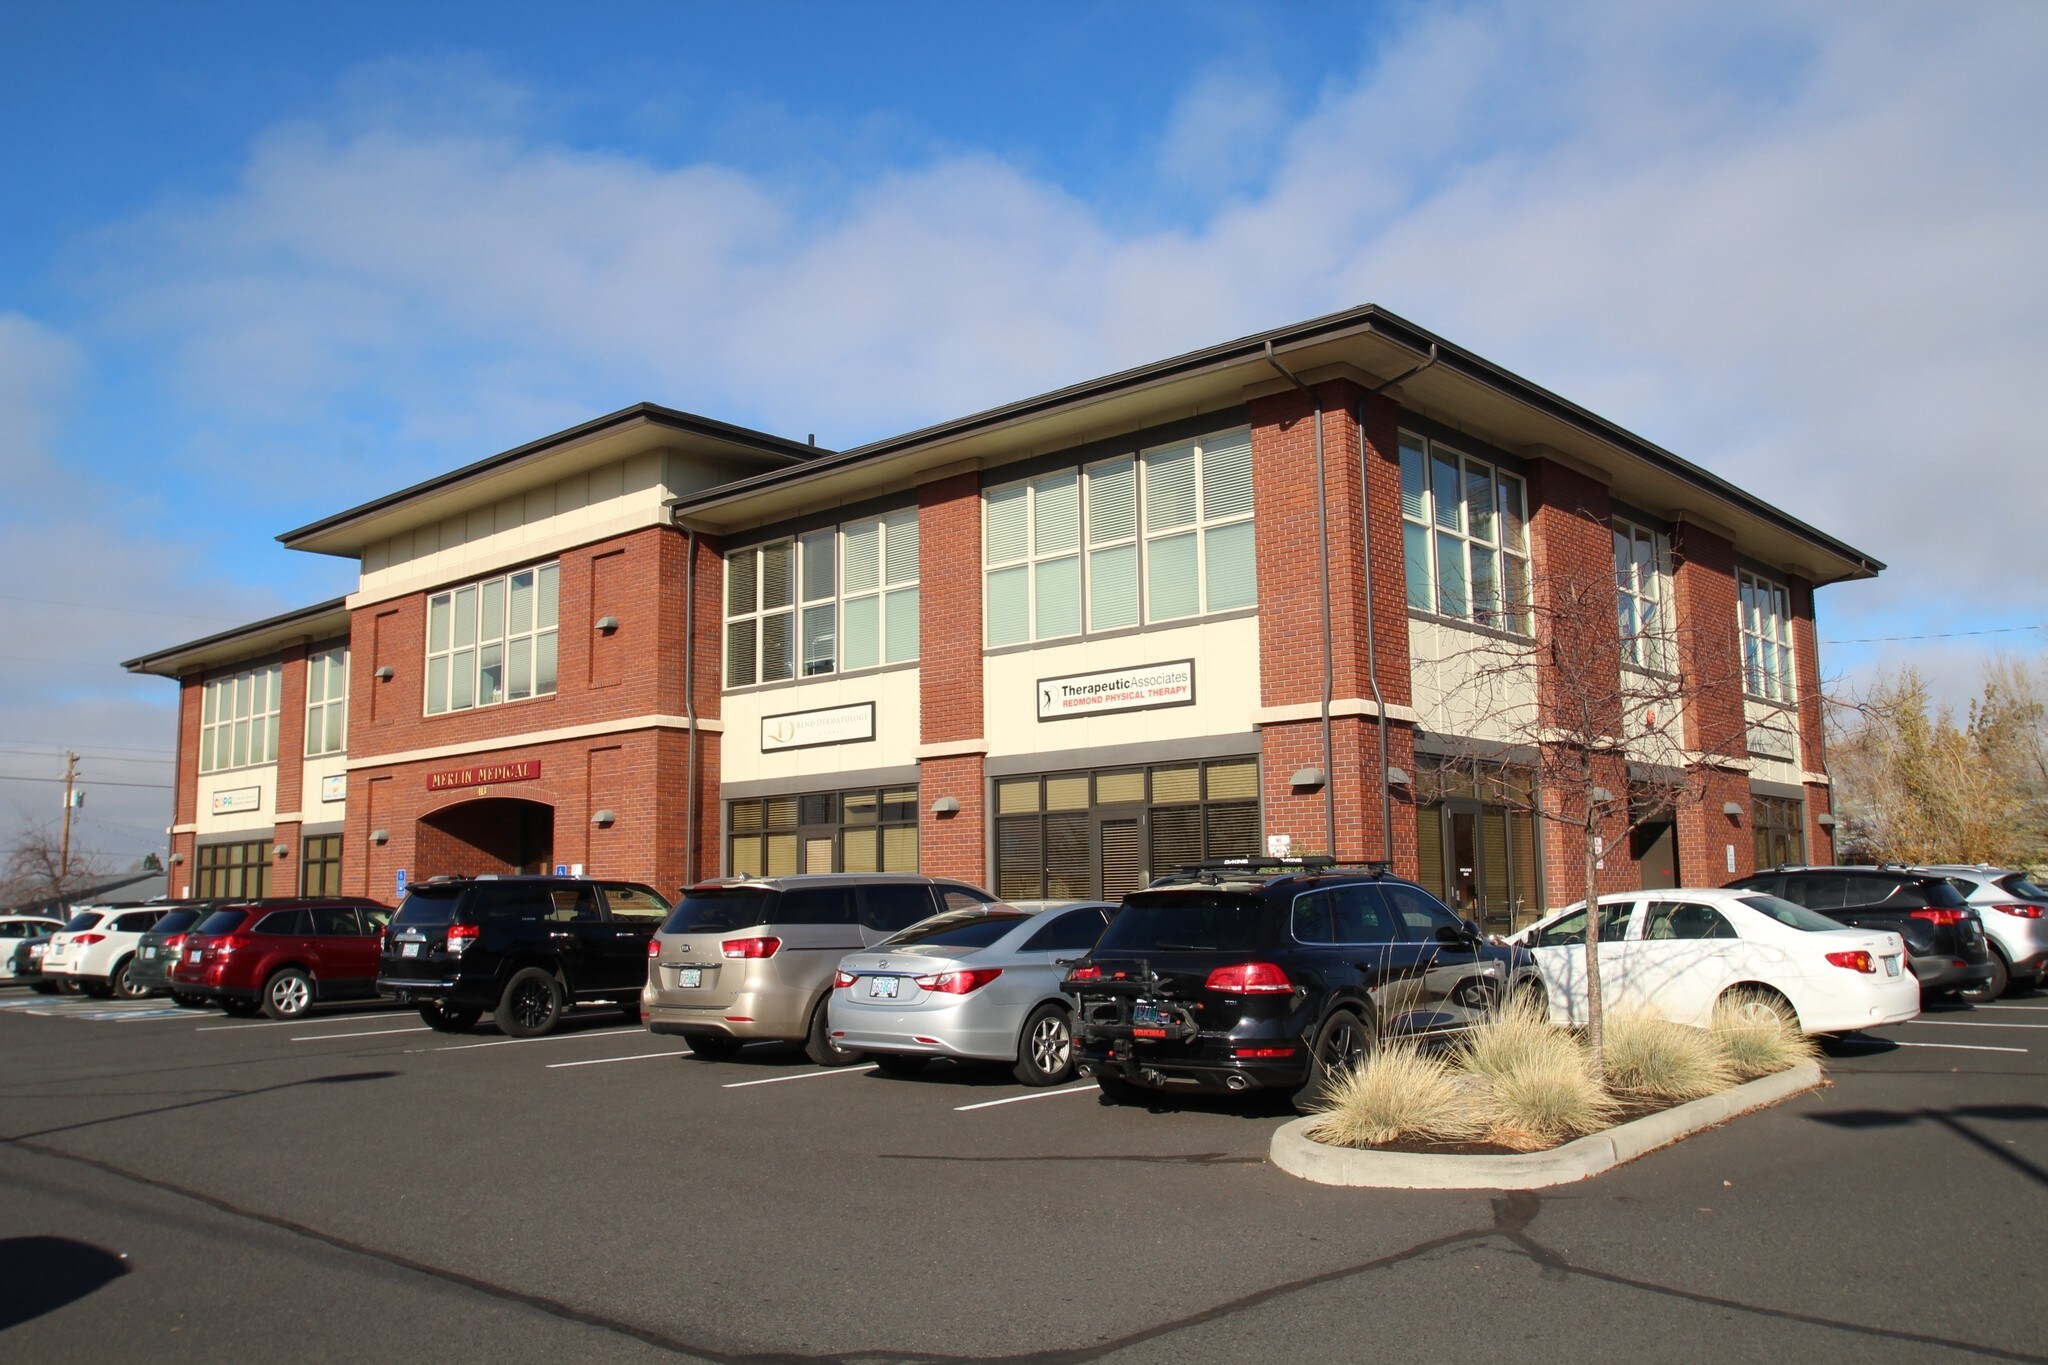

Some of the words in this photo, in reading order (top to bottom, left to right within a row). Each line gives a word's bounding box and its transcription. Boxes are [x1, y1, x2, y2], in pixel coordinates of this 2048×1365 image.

[1062, 696, 1103, 708] REDMOND
[1105, 692, 1145, 703] PHYSICAL
[1148, 685, 1187, 697] THERAPY
[816, 713, 868, 727] DERMATOLOGY
[432, 770, 472, 788] MERLIN
[478, 762, 530, 782] MEDICAL
[1132, 1028, 1166, 1038] YAKIMA
